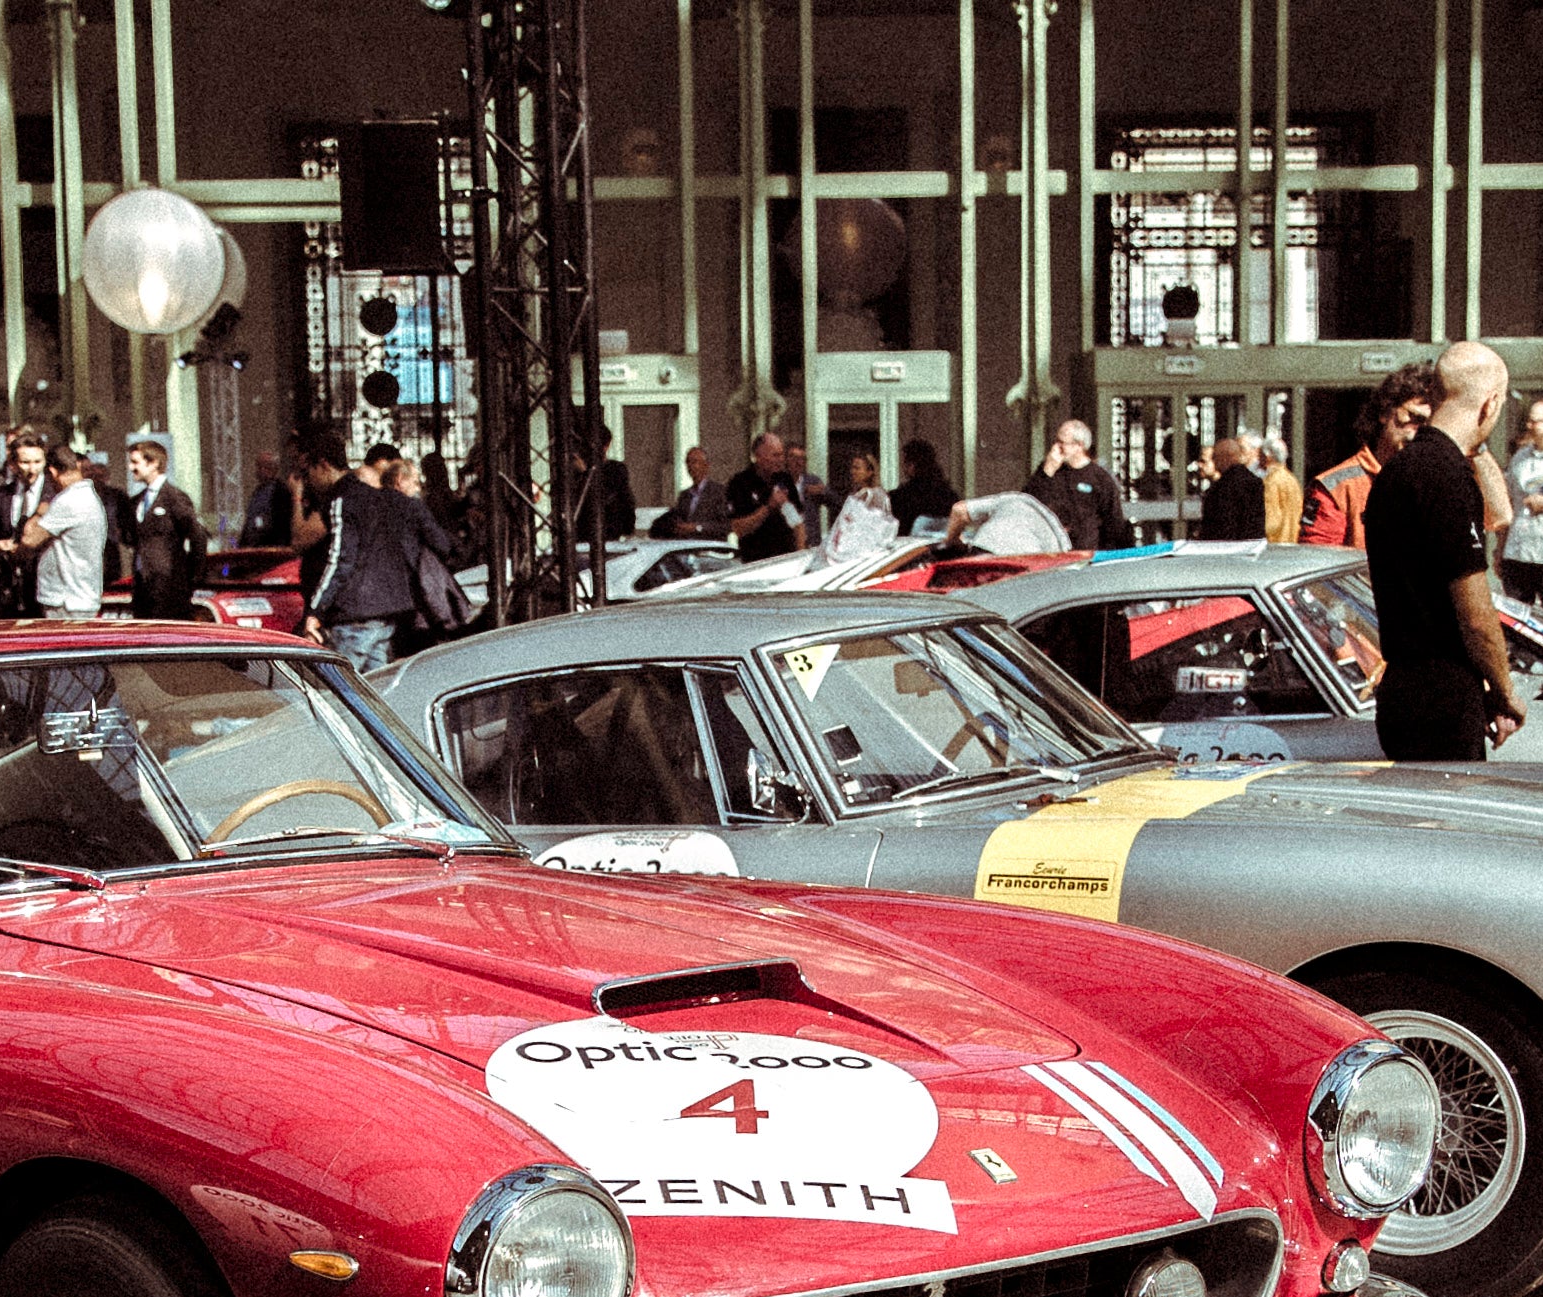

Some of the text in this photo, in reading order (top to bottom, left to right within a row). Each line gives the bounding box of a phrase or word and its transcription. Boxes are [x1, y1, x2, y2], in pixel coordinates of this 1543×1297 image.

[794, 654, 813, 672] 3
[1033, 862, 1067, 875] Ecurie
[987, 874, 1109, 894] Francorchamps
[515, 1041, 873, 1070] Optic 2000
[679, 1078, 770, 1134] 4
[598, 1179, 911, 1214] ZENITH
